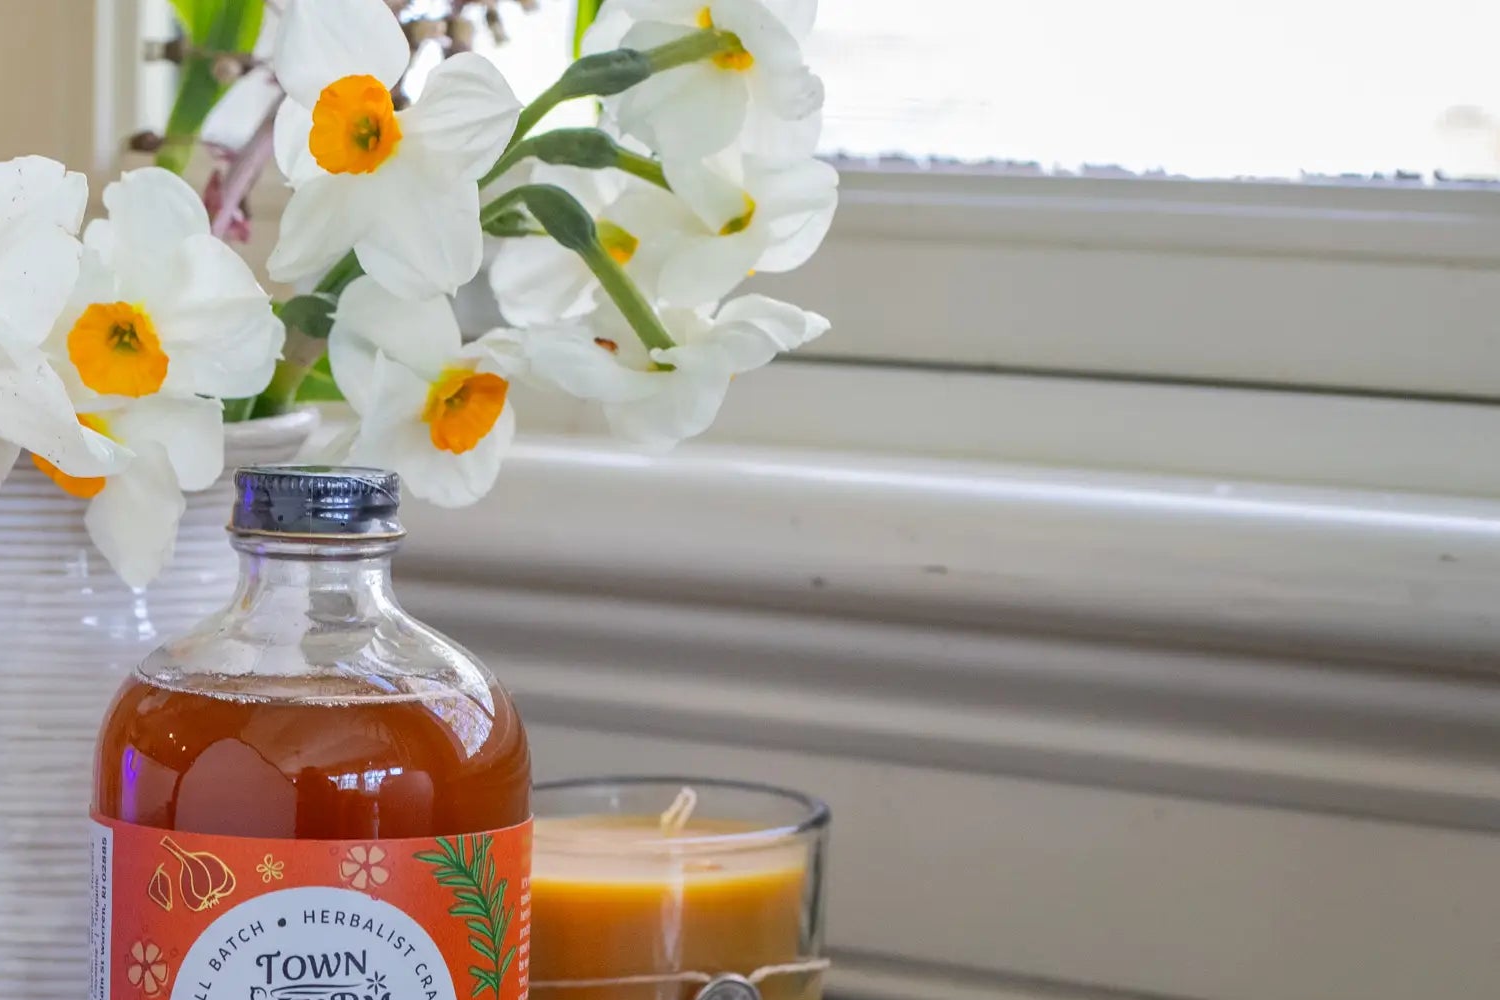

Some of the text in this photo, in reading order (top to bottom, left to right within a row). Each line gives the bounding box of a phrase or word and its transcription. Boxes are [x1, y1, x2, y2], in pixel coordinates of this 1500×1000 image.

[208, 920, 264, 972] BATCH
[303, 909, 416, 958] HERBALIST
[255, 949, 368, 985] TOWN
